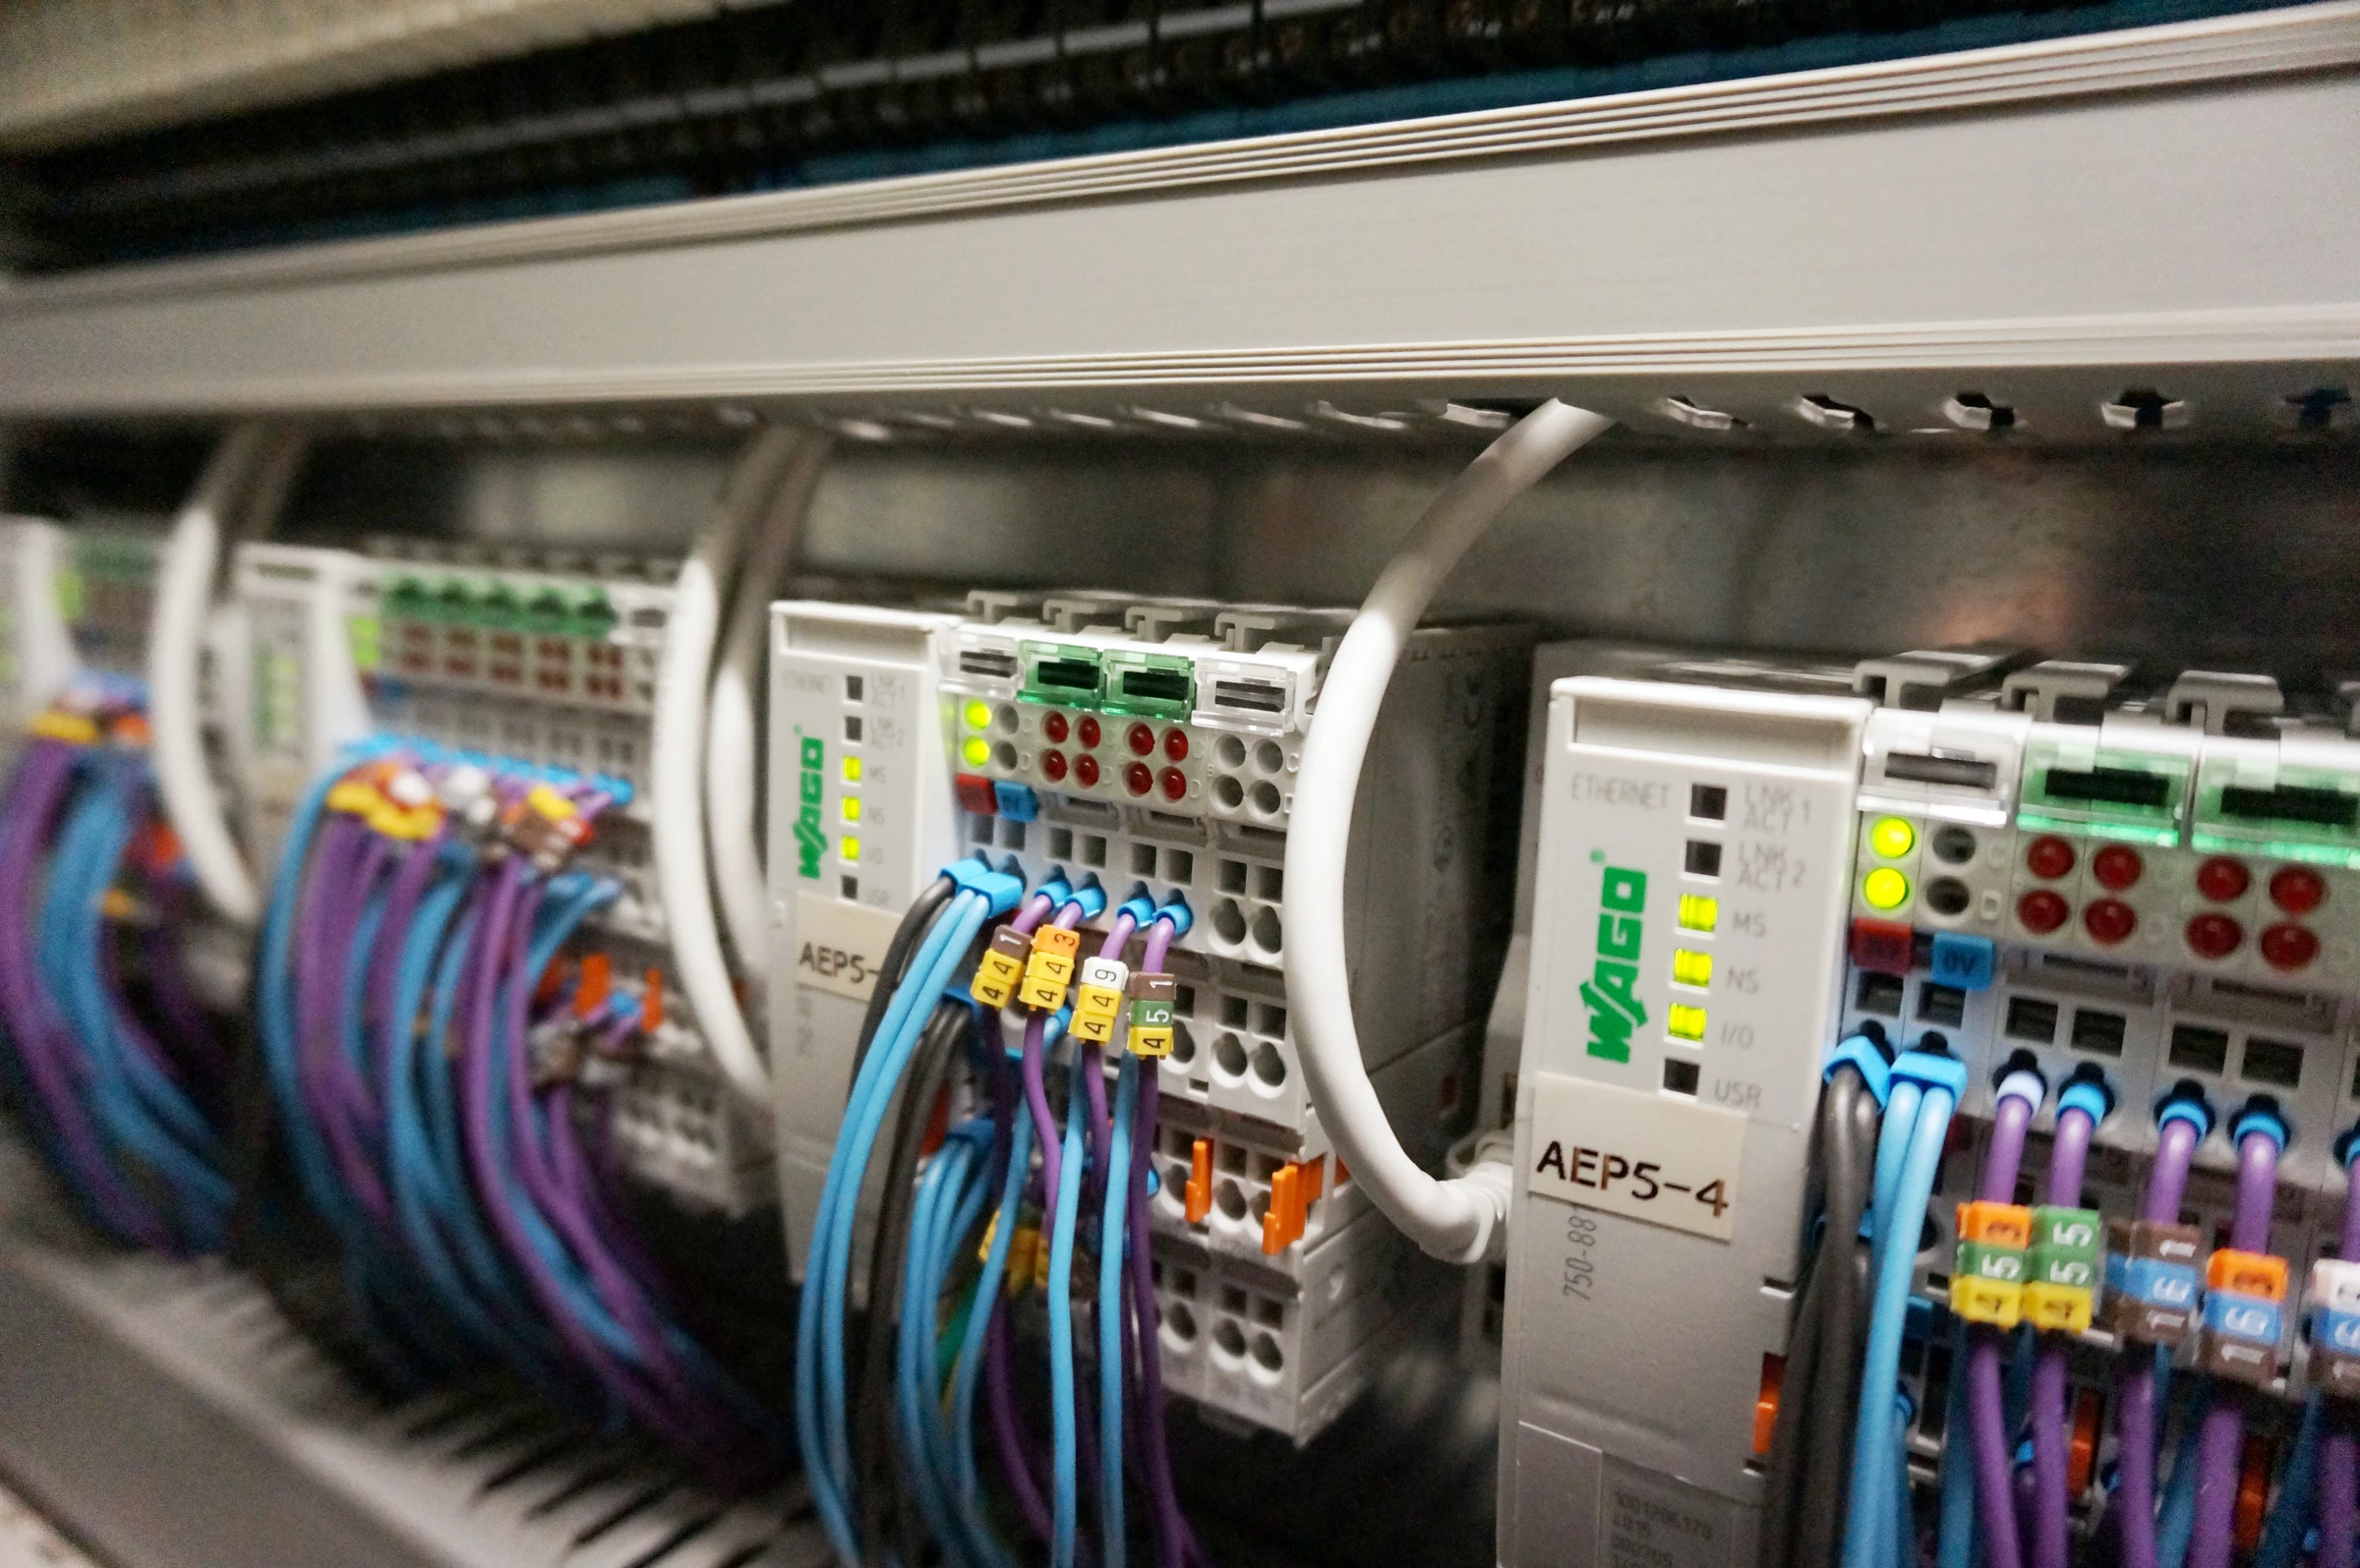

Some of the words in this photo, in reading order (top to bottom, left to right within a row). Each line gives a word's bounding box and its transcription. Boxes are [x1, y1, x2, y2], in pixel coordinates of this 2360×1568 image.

[792, 735, 829, 880] WAGO
[1570, 773, 1670, 811] ETHERNET
[1743, 782, 1794, 813] LNK
[1742, 803, 1792, 833] ACT
[1738, 840, 1788, 868] LNK
[1737, 862, 1787, 895] ACT
[1792, 859, 1806, 890] 2
[1731, 910, 1767, 939] MS
[798, 940, 880, 985] AEP5-
[1578, 865, 1649, 1065] WAGO
[1727, 968, 1761, 996] NS
[1720, 1023, 1755, 1049] I/O
[1714, 1077, 1763, 1110] USR
[1535, 1139, 1730, 1220] AEP5-4
[1562, 1209, 1599, 1304] 750-88
